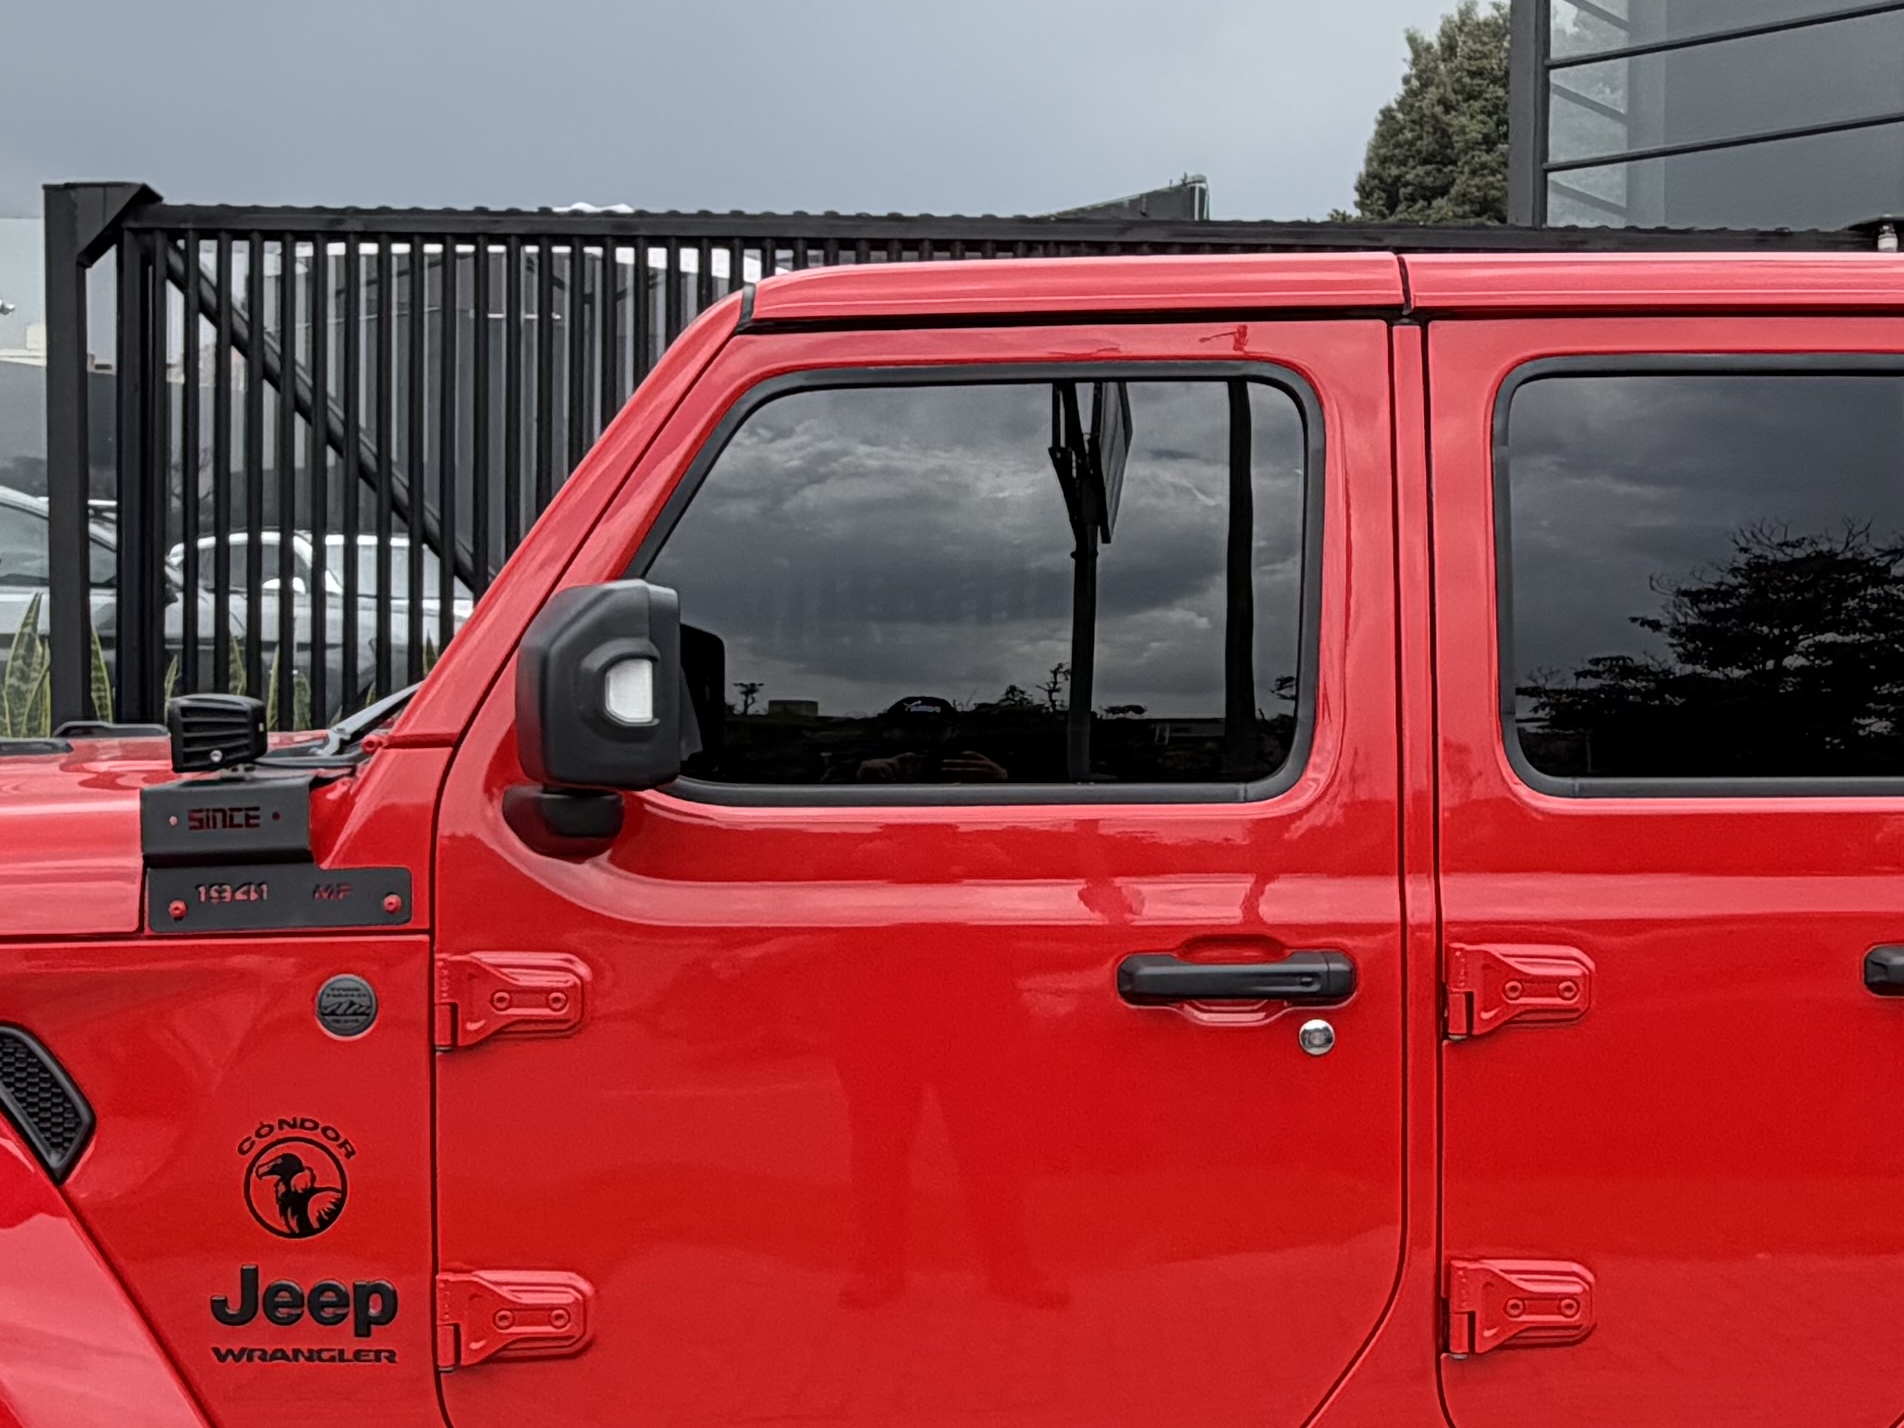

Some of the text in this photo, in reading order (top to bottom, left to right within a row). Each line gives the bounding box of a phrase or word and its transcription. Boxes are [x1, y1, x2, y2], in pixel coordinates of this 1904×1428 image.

[187, 805, 261, 832] SINCE
[195, 880, 269, 904] 1941
[210, 1263, 399, 1339] Jeep
[210, 1346, 398, 1364] WRANGLER
